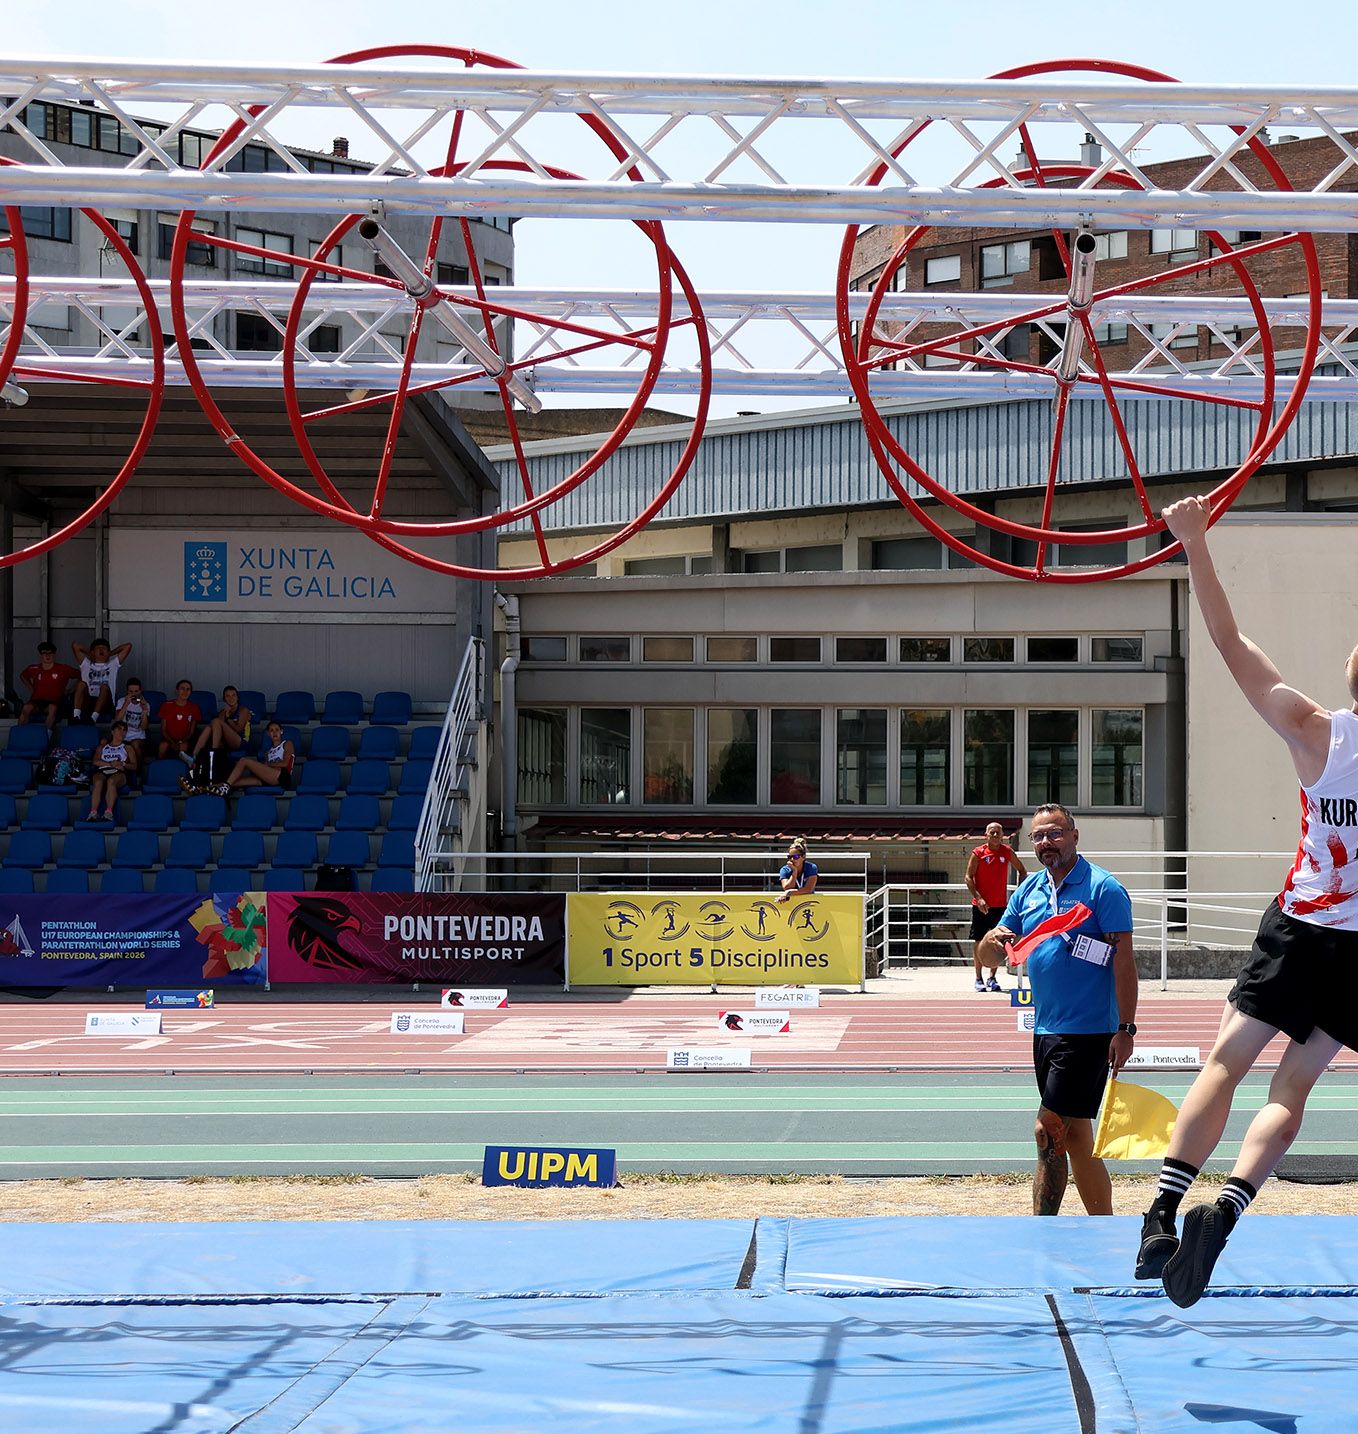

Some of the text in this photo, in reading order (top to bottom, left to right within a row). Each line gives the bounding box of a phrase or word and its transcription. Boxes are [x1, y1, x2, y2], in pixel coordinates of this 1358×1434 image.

[240, 548, 335, 570] XUNTA
[238, 576, 397, 598] DE GALICIA
[41, 921, 97, 929] PENTATHLON
[384, 915, 545, 941] PONTEVEDRA
[41, 930, 180, 940] U17 EUROPEAN CHAMPIONSHIPS &
[41, 940, 180, 949] PARATETRATHLON WORLD SERIES
[41, 951, 145, 961] PONTEVEDRA, SPAIN 2026
[402, 947, 525, 960] MULTISPORT
[602, 947, 829, 972] 1 Sport 5 Disciplines
[1152, 1055, 1197, 1064] Pontevedra
[498, 1151, 598, 1182] UIPM
